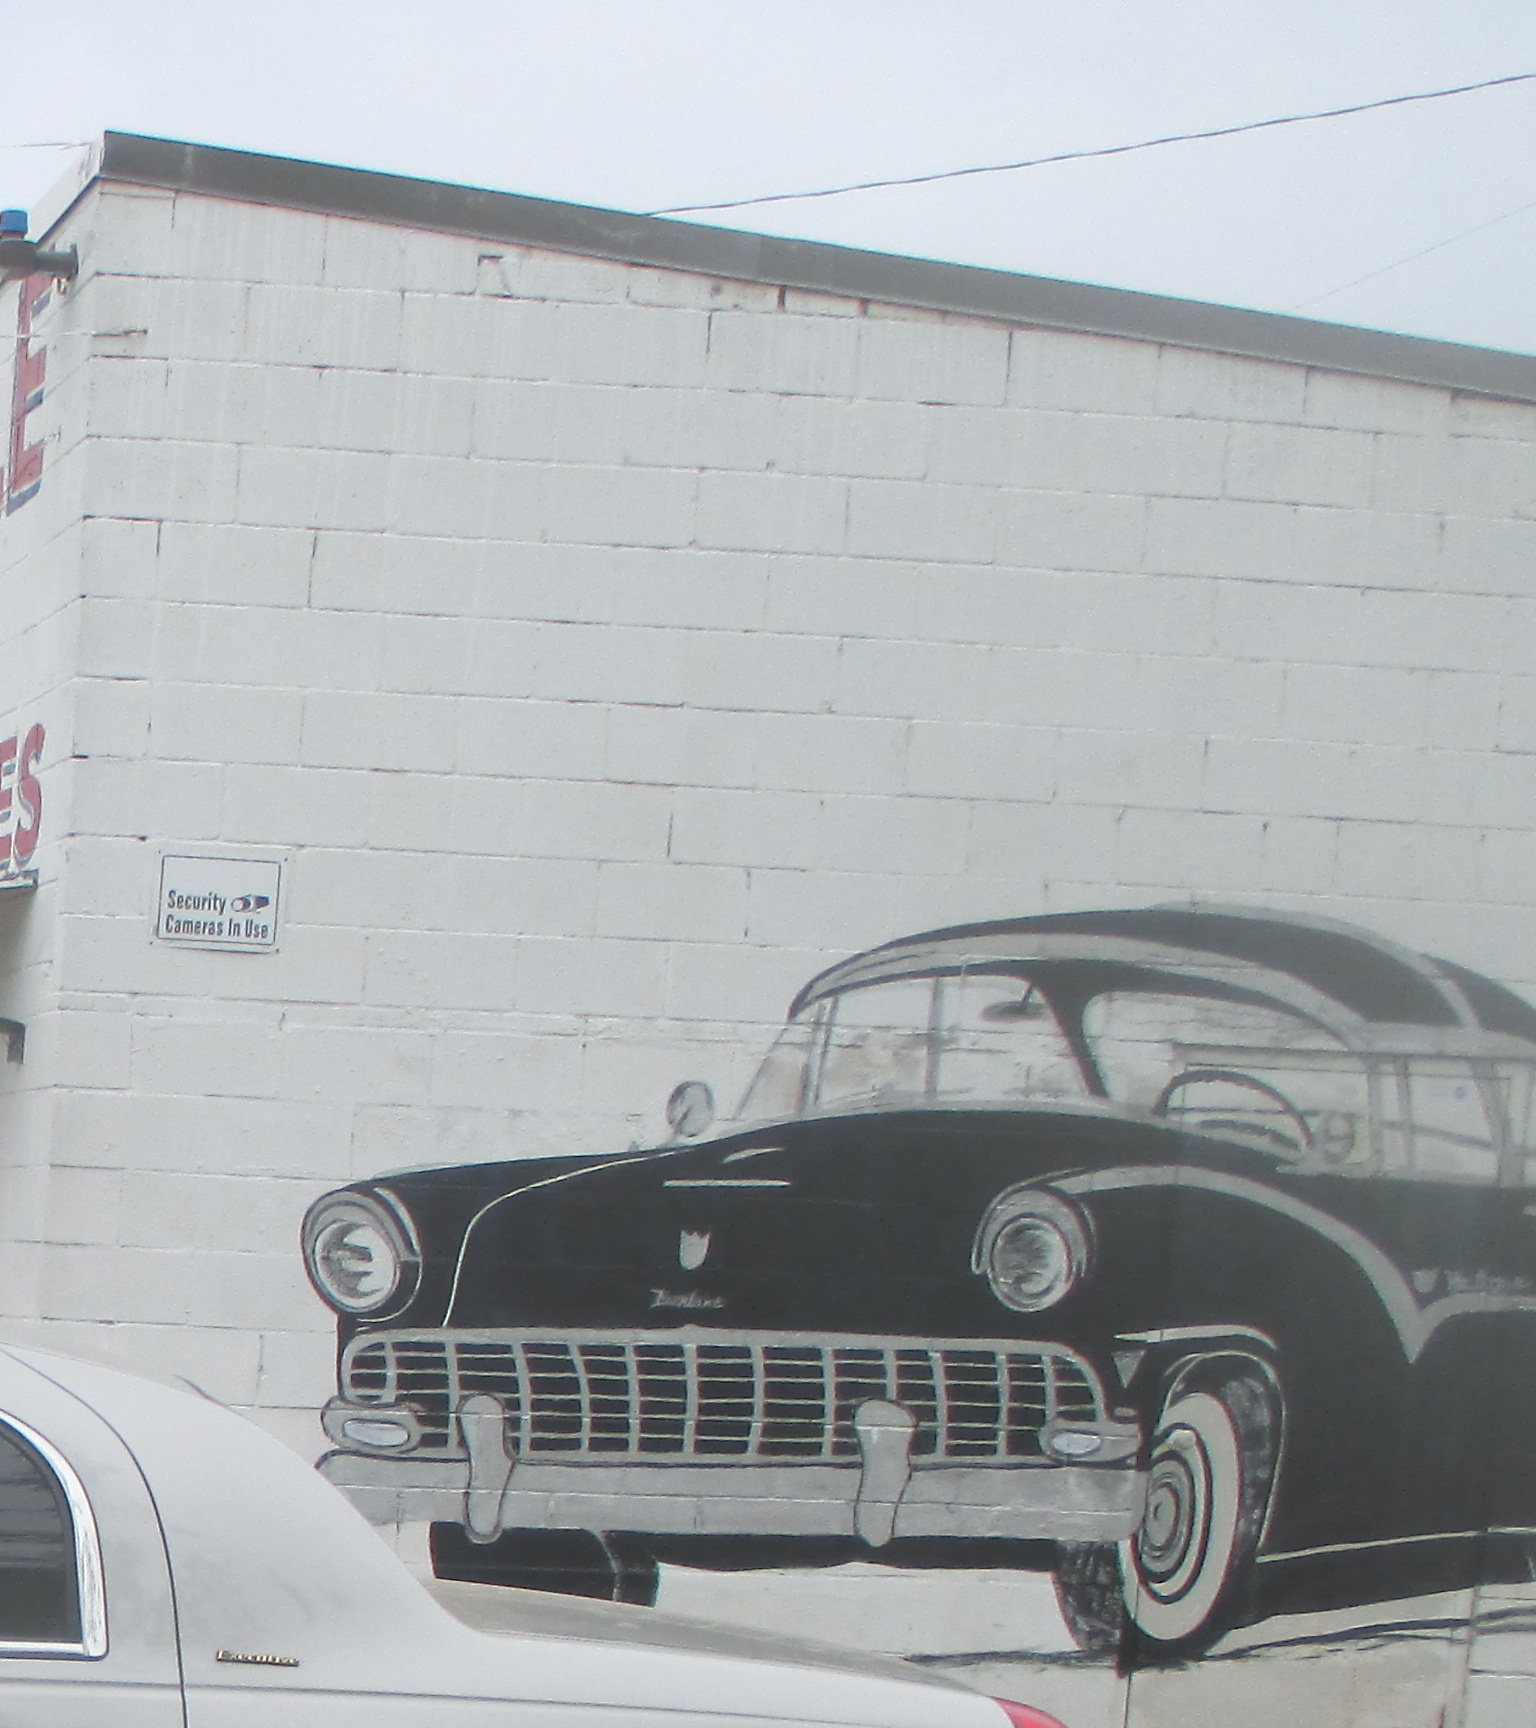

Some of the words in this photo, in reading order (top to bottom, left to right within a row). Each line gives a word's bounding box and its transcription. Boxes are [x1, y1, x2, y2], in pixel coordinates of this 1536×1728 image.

[167, 889, 227, 916] Security
[165, 914, 224, 937] Cameras
[228, 918, 241, 939] In
[245, 919, 269, 940] Use
[217, 1650, 300, 1667] Executive
